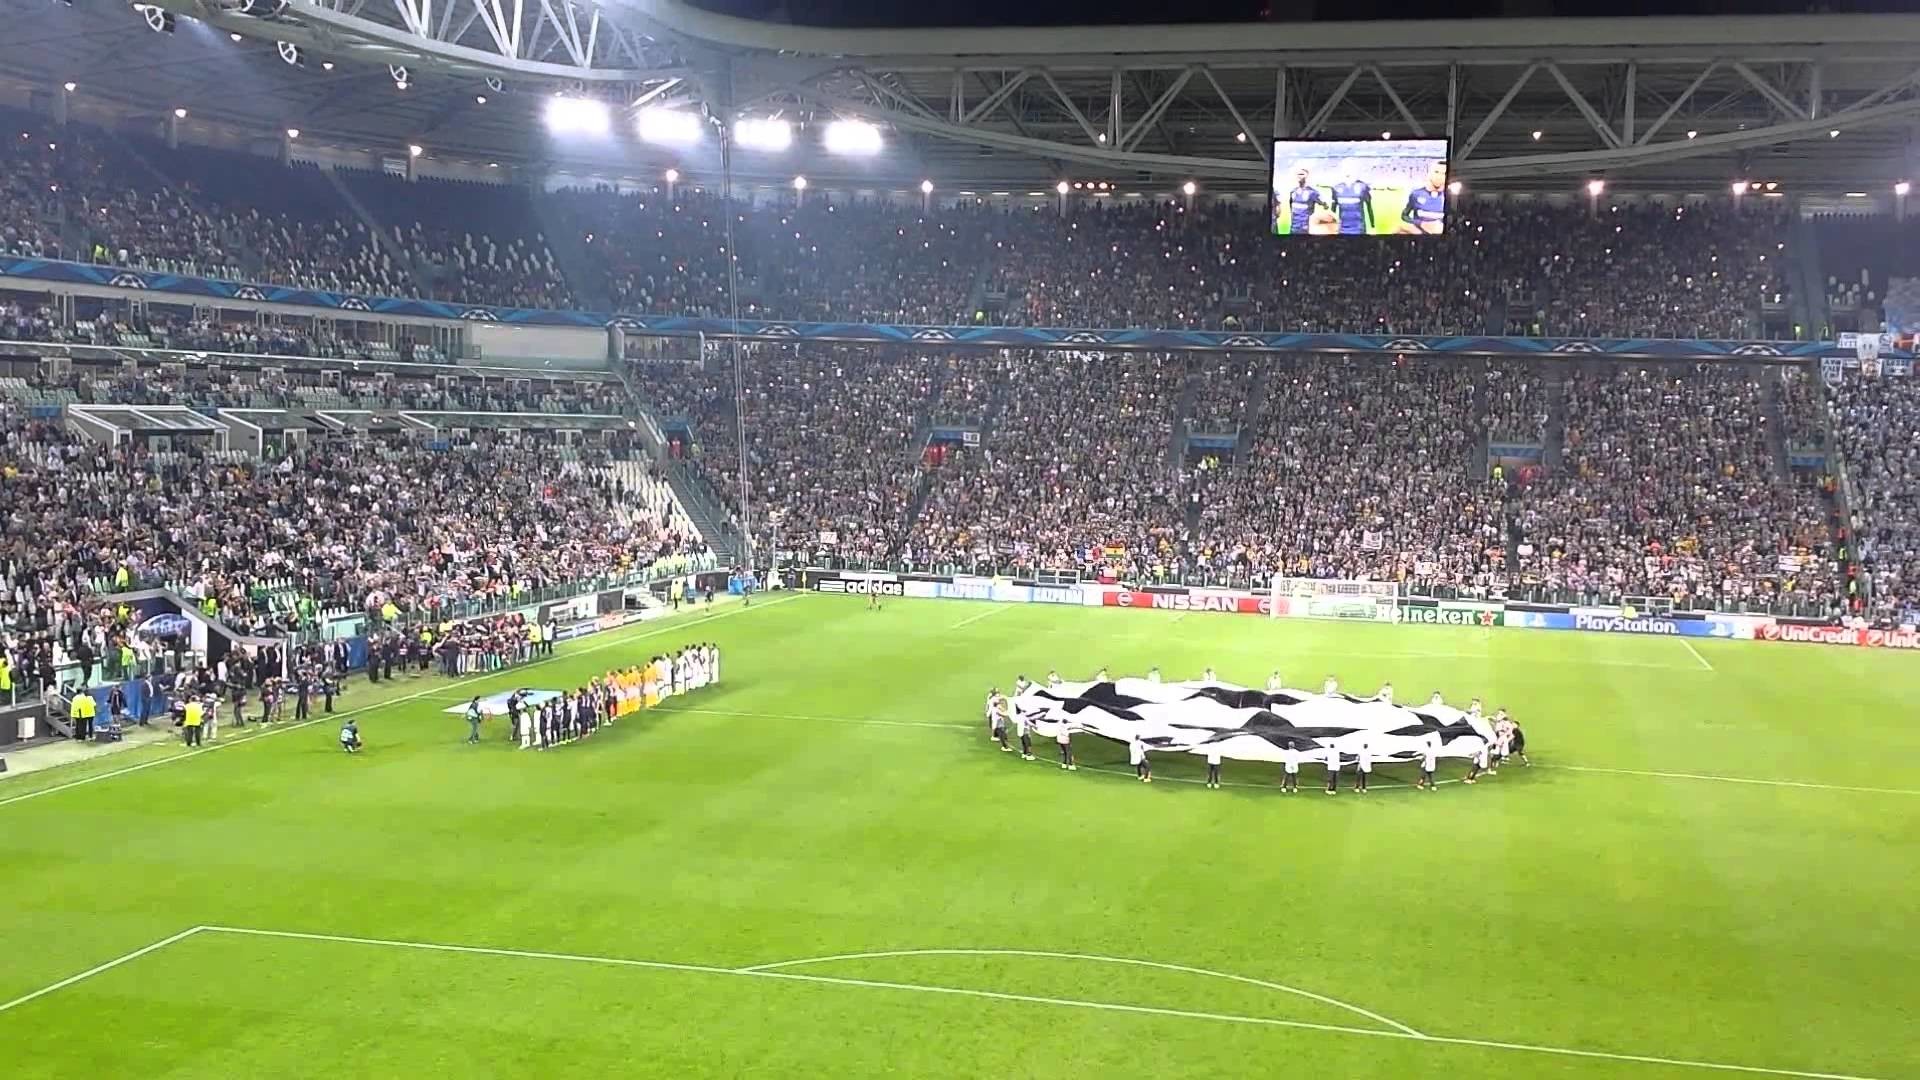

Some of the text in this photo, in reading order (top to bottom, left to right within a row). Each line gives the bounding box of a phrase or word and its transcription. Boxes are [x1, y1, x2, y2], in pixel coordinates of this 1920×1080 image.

[846, 578, 903, 596] adidas
[1152, 592, 1239, 612] NISSAN
[1576, 614, 1676, 634] PlayStation
[1782, 624, 1860, 645] UniCredit
